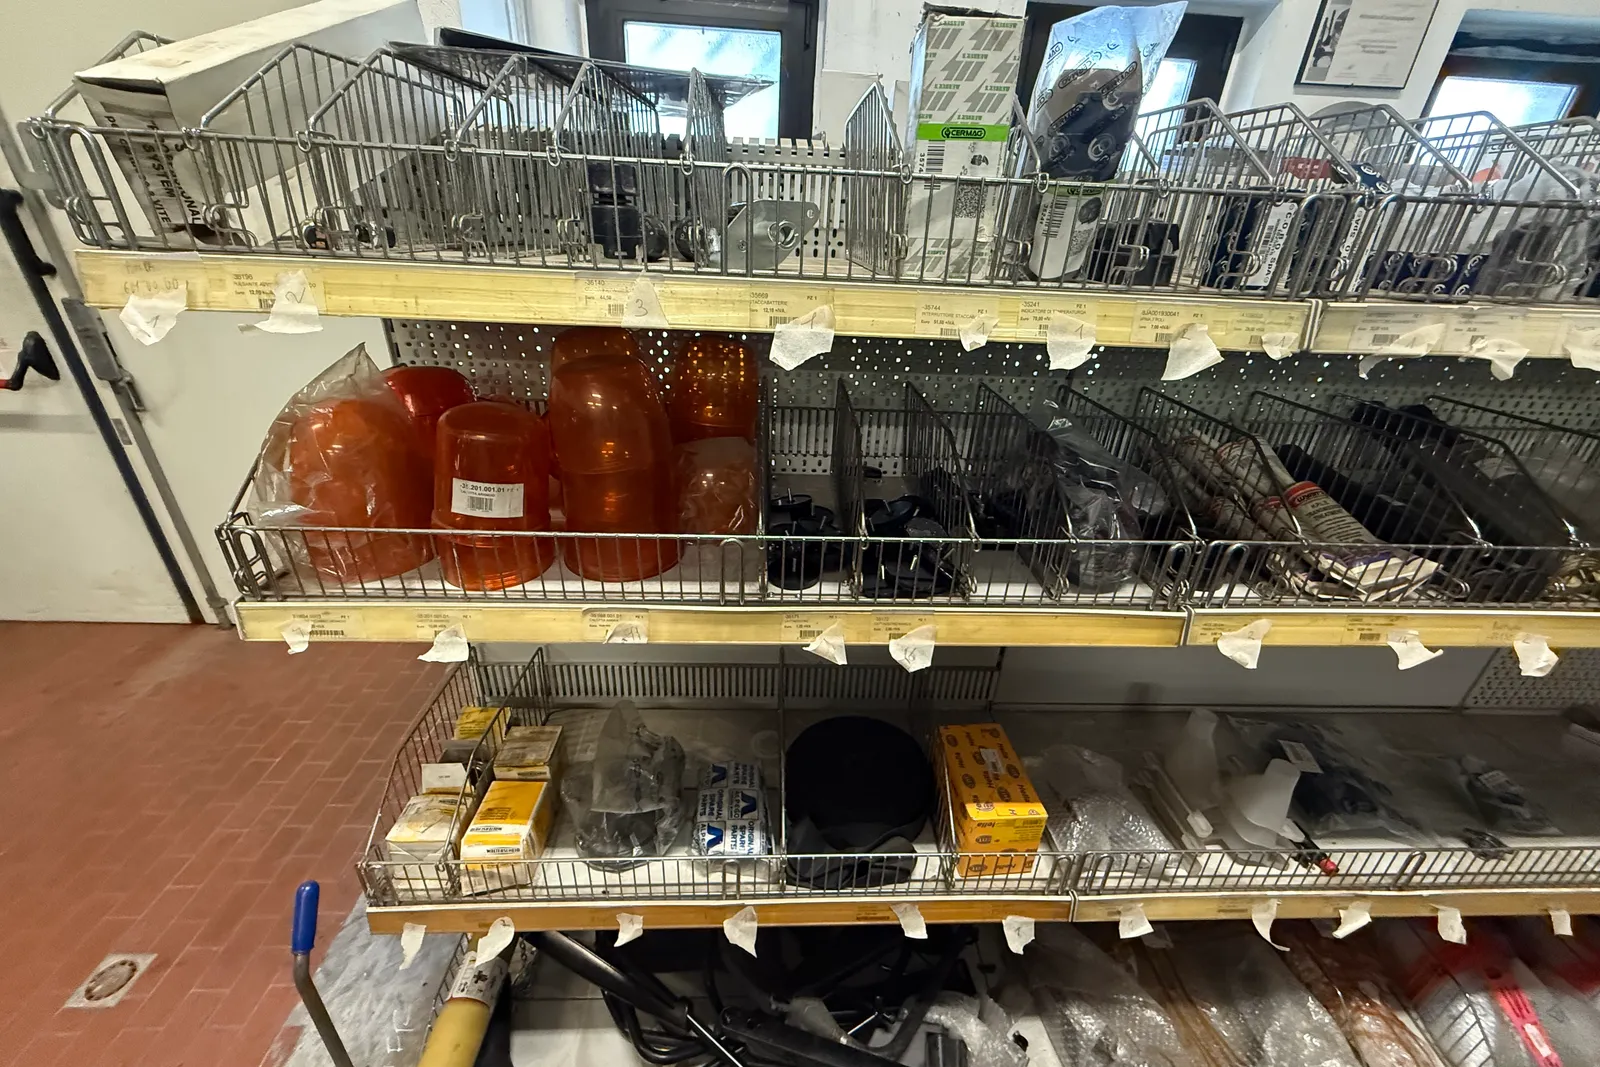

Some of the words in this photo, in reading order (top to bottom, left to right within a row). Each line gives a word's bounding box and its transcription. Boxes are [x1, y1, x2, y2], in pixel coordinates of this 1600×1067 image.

[142, 143, 177, 198] SYSTEM
[153, 200, 171, 223] VITE
[285, 286, 306, 304] 2
[634, 298, 649, 317] 3
[976, 322, 985, 336] 1
[1075, 323, 1084, 339] 1
[708, 793, 716, 818] SPARE
[716, 789, 724, 820] ORIGINAL
